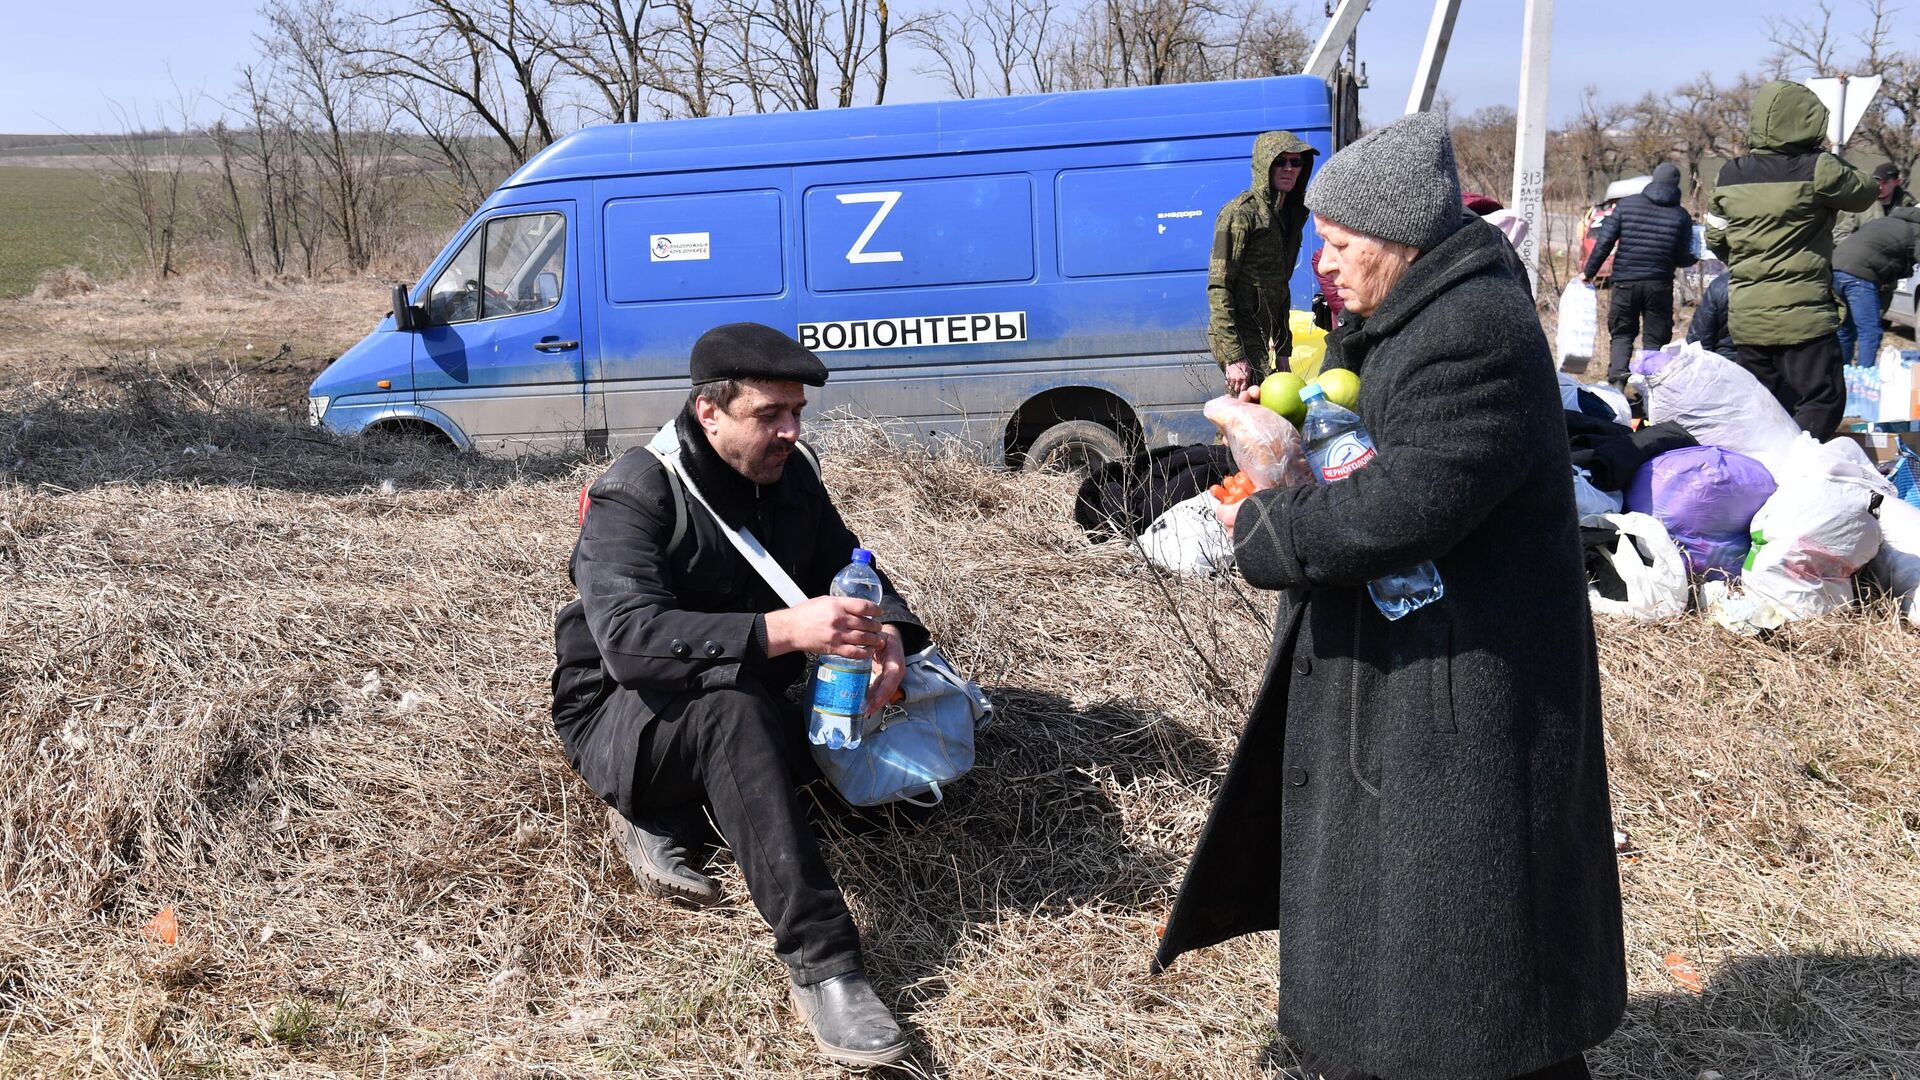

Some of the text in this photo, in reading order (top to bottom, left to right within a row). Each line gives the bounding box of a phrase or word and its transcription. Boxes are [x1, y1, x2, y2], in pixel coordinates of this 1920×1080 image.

[1520, 171, 1541, 186] 313
[836, 191, 904, 264] Z
[798, 313, 1026, 350] ВОЛОНТЕРЫ
